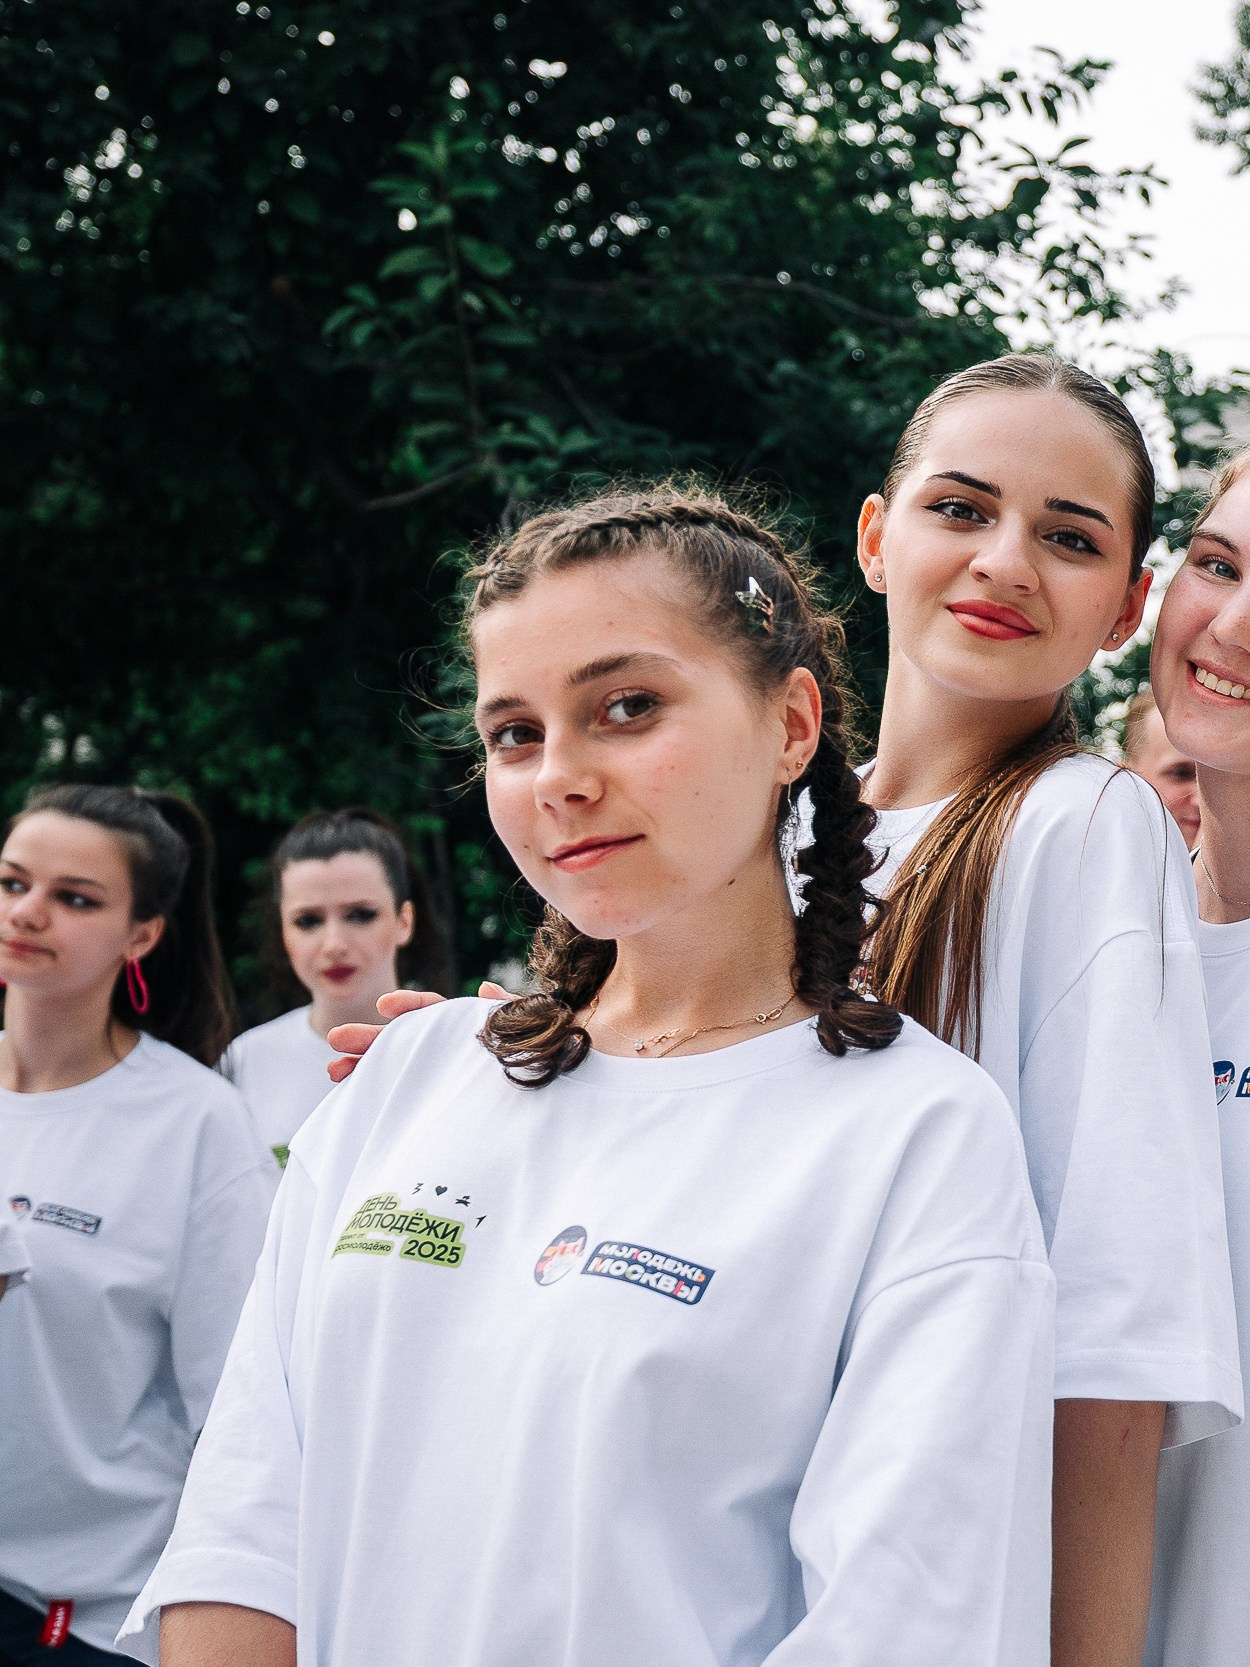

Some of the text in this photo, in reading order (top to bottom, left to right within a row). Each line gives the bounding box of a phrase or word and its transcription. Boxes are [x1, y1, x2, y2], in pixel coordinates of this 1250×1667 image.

[355, 1196, 398, 1216] ДЕНЬ
[346, 1212, 461, 1243] МОЛОДЁЖИ
[403, 1240, 461, 1264] 2025
[598, 1244, 706, 1282] МОЛОДЕЖЬ
[587, 1257, 701, 1302] МОСКВЫ
